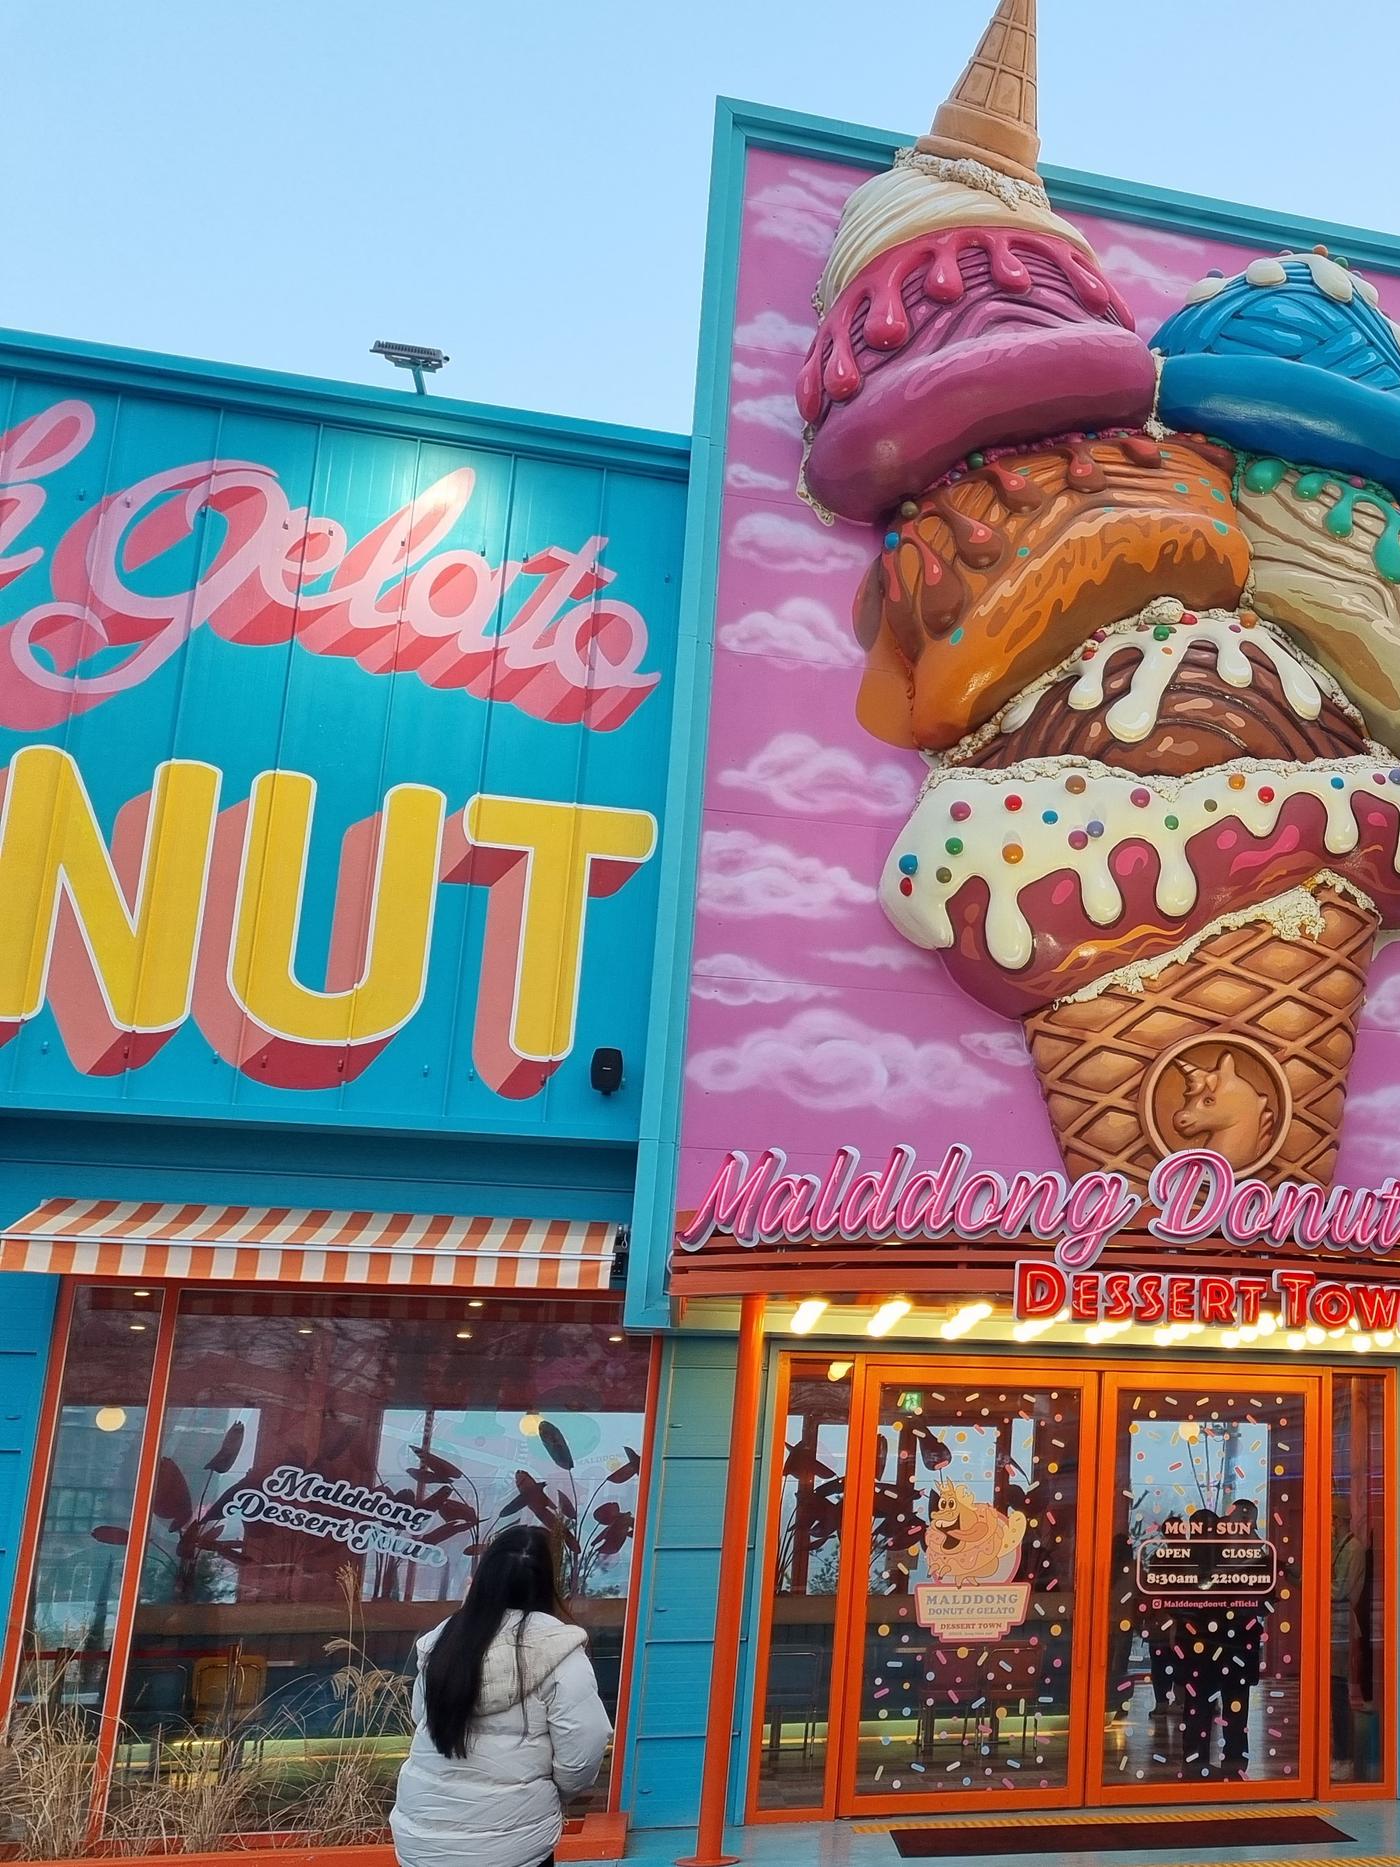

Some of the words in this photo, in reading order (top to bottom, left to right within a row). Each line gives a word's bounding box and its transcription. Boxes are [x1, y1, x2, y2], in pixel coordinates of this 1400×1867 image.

[11, 459, 662, 695] Gelato
[0, 743, 658, 1063] NUT
[678, 1144, 1138, 1268] Malddong
[1015, 1260, 1268, 1325] DESSERT
[224, 1490, 353, 1541] Dessert
[263, 1467, 436, 1535] Malddong
[1156, 1548, 1191, 1559] OPEN
[1222, 1548, 1262, 1559] CLOSE
[1165, 1521, 1203, 1535] MON
[1216, 1521, 1252, 1535] SUN
[926, 1594, 1018, 1605] MALDDONG
[1146, 1573, 1199, 1584] 8:30am
[1211, 1573, 1271, 1586] 22:00pm
[928, 1607, 964, 1616] DONUT
[976, 1606, 1015, 1615] GELATO
